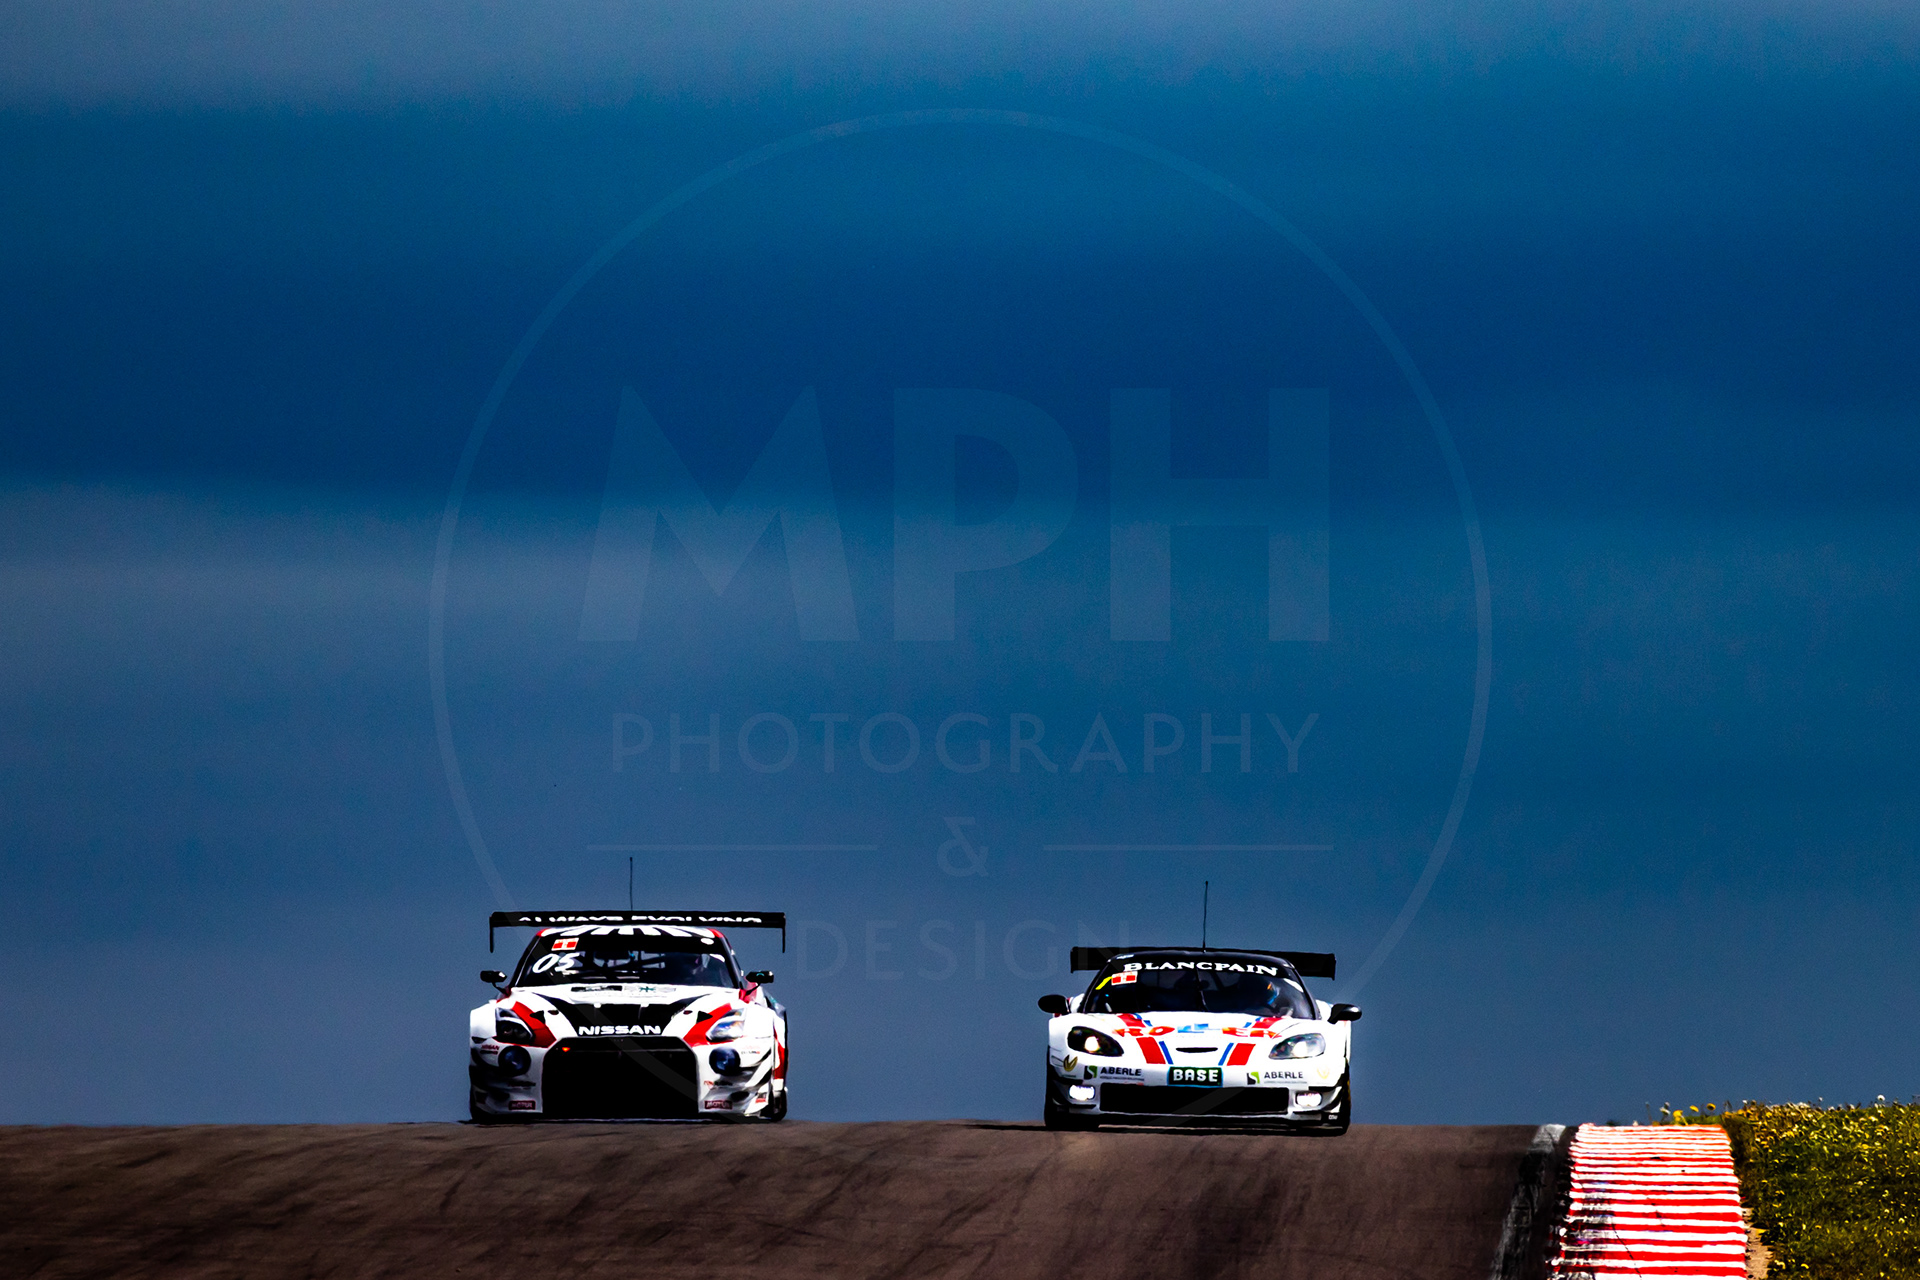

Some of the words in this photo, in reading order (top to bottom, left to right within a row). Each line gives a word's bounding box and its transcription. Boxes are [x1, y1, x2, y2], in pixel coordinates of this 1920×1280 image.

[1124, 961, 1278, 977] BLANCPAIN
[578, 1024, 661, 1036] NISSAN
[1100, 1066, 1142, 1076] ABERLE
[1173, 1069, 1219, 1082] BASE
[1264, 1071, 1304, 1079] ABERLE
